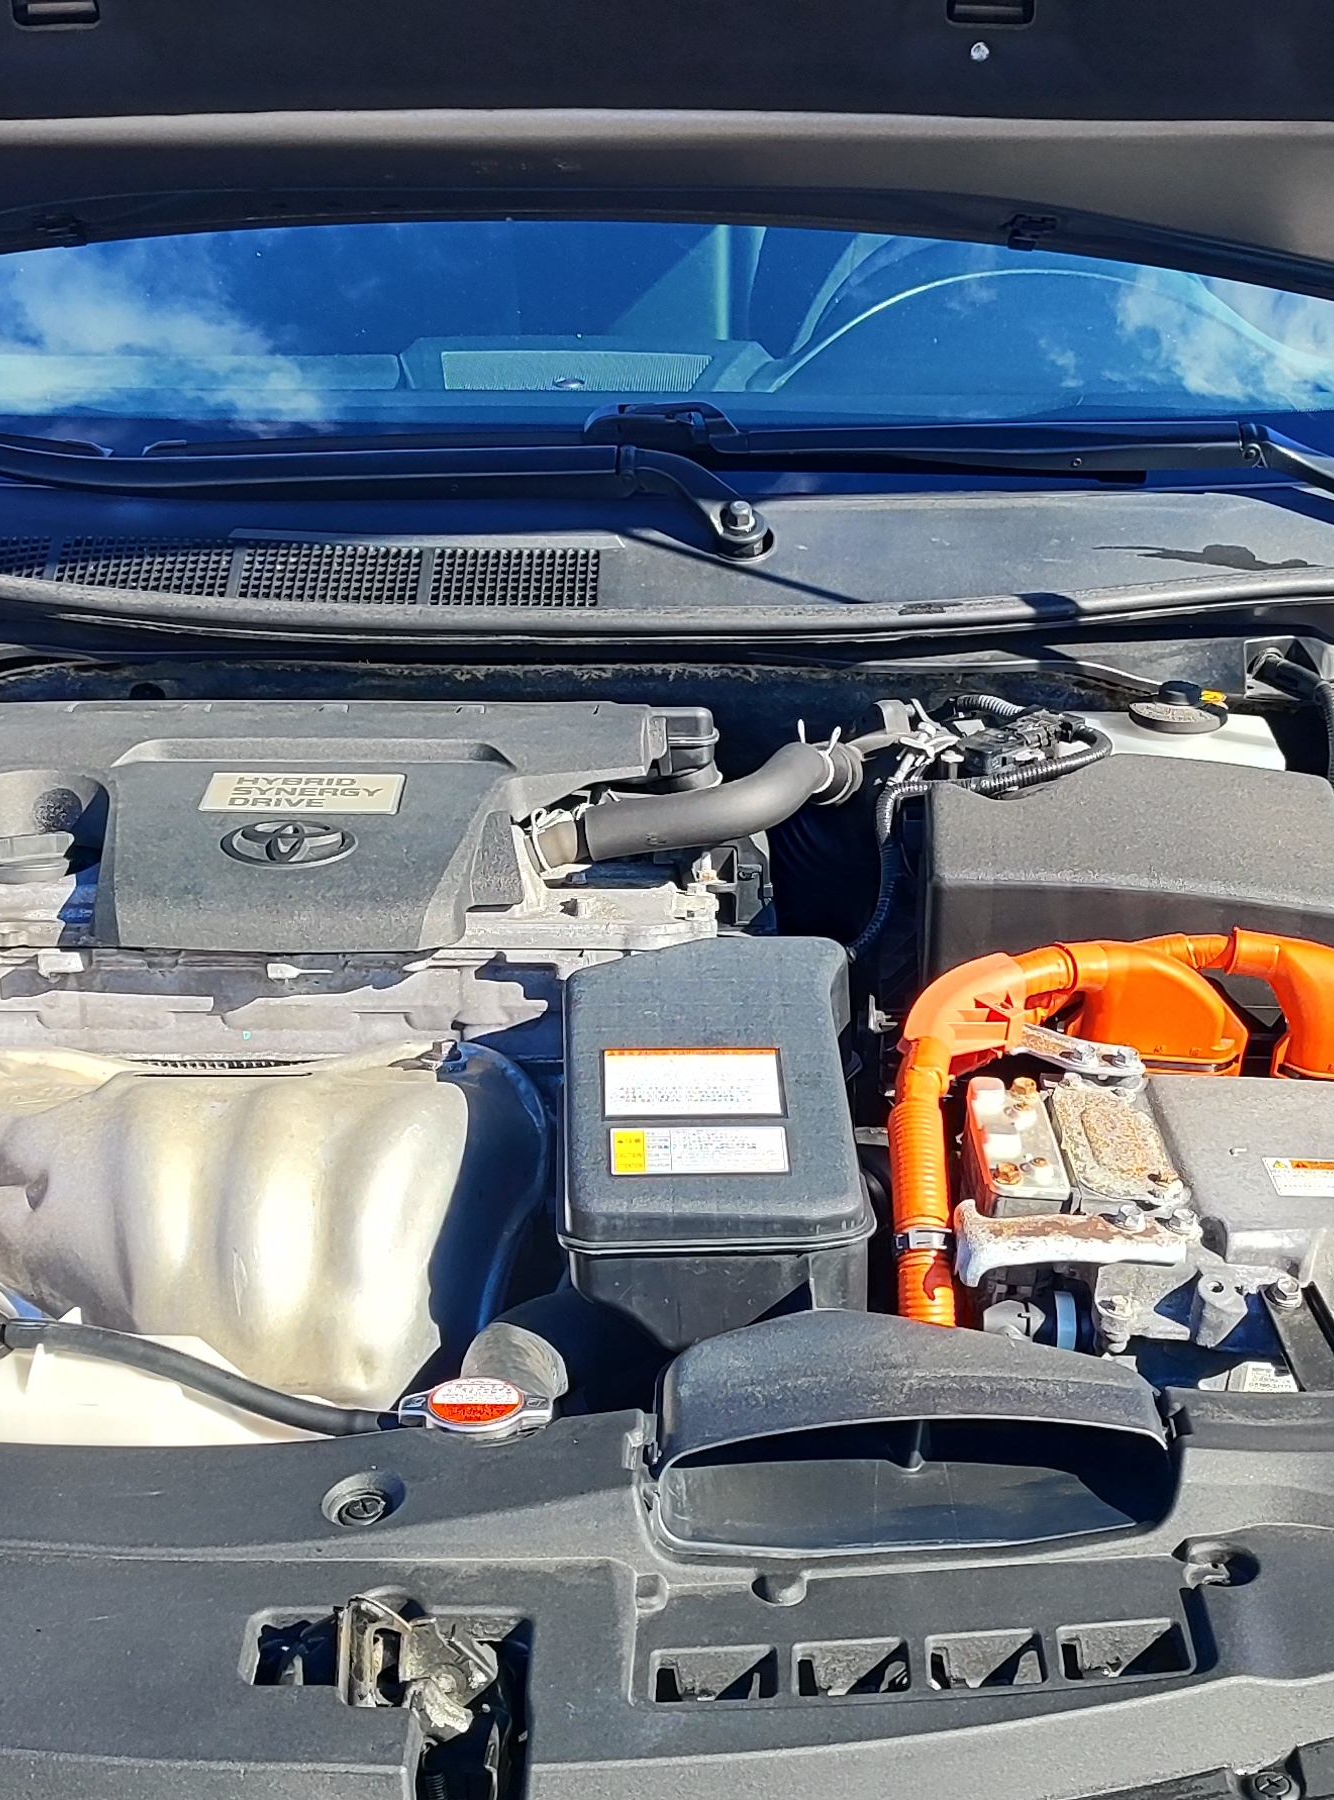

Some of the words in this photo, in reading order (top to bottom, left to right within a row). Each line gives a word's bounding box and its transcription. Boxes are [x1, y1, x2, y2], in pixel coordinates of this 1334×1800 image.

[236, 777, 357, 786] HYBRID
[231, 787, 383, 797] SYNERGY
[227, 797, 326, 807] DRIVE
